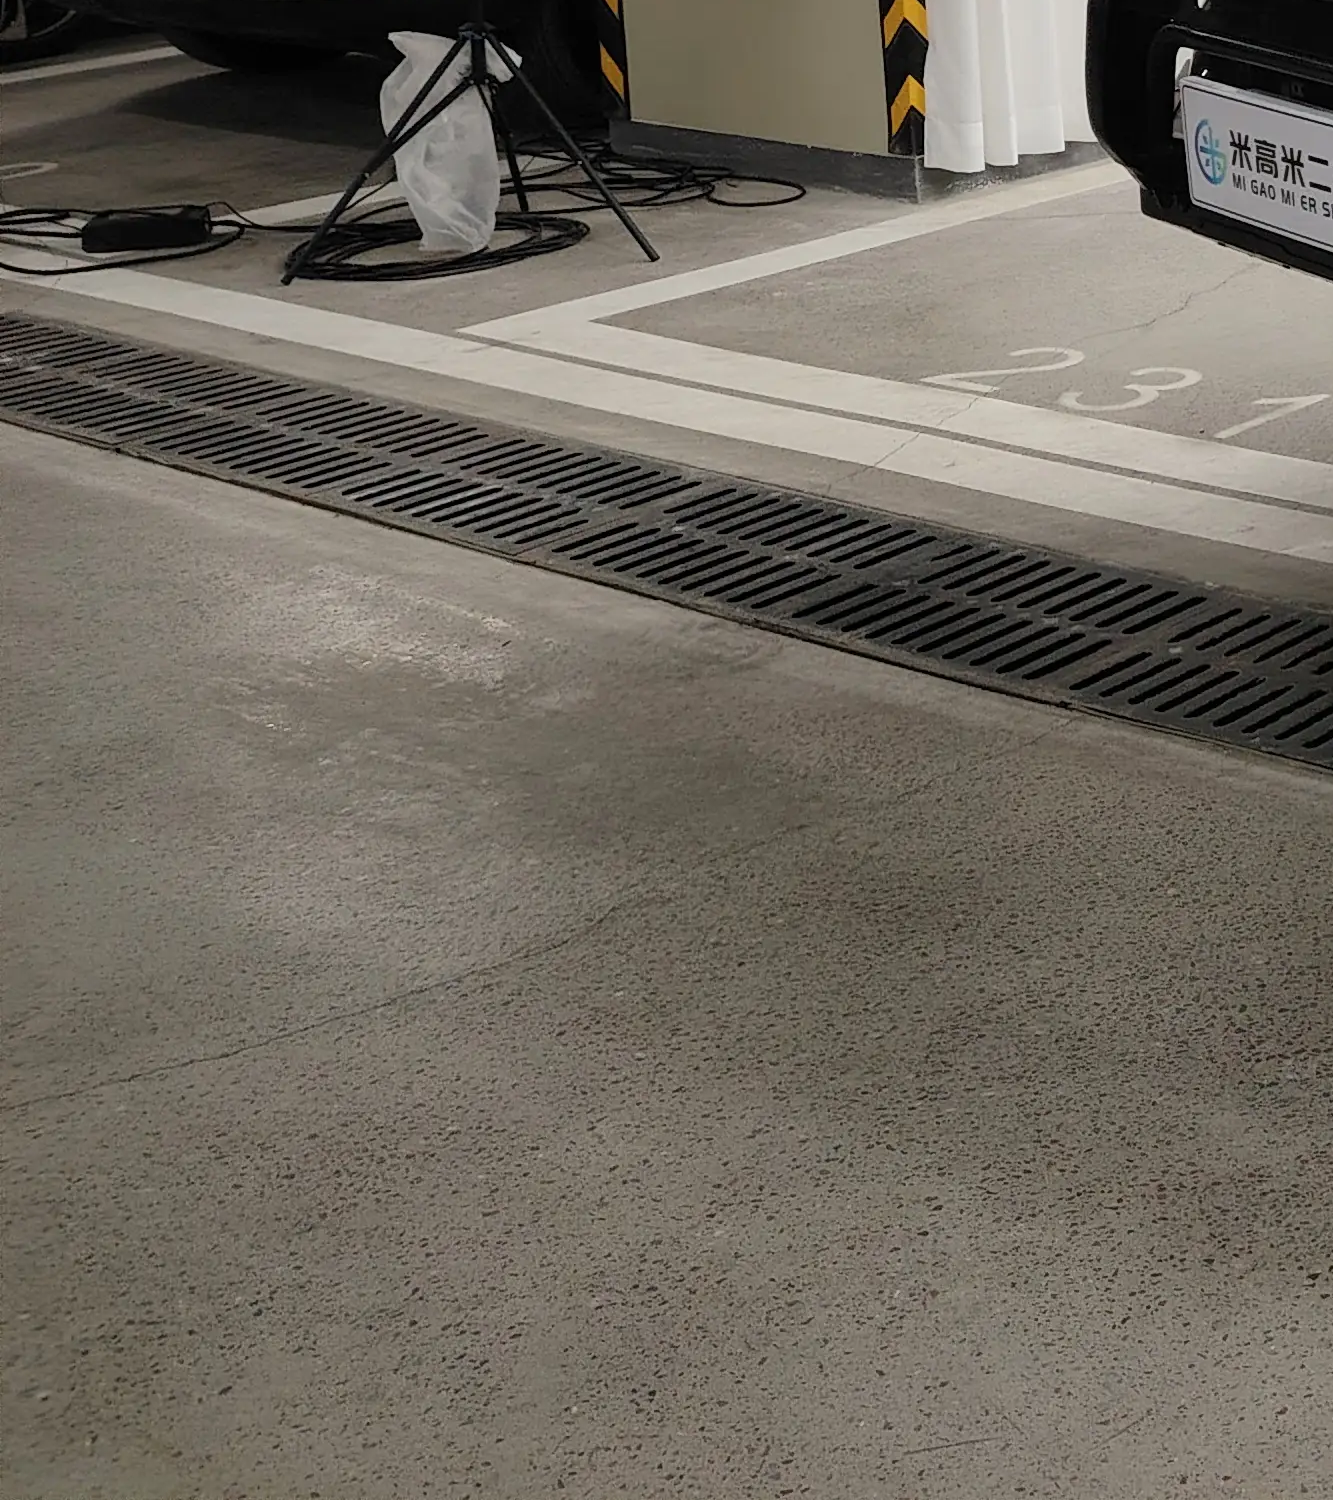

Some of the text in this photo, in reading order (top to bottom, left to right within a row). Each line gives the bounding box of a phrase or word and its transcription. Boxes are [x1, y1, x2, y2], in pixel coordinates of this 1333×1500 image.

[1233, 173, 1246, 192] MI
[1251, 176, 1276, 201] GAO
[1281, 187, 1296, 208] MI
[1300, 196, 1317, 214] ER
[919, 346, 1331, 440] 231
